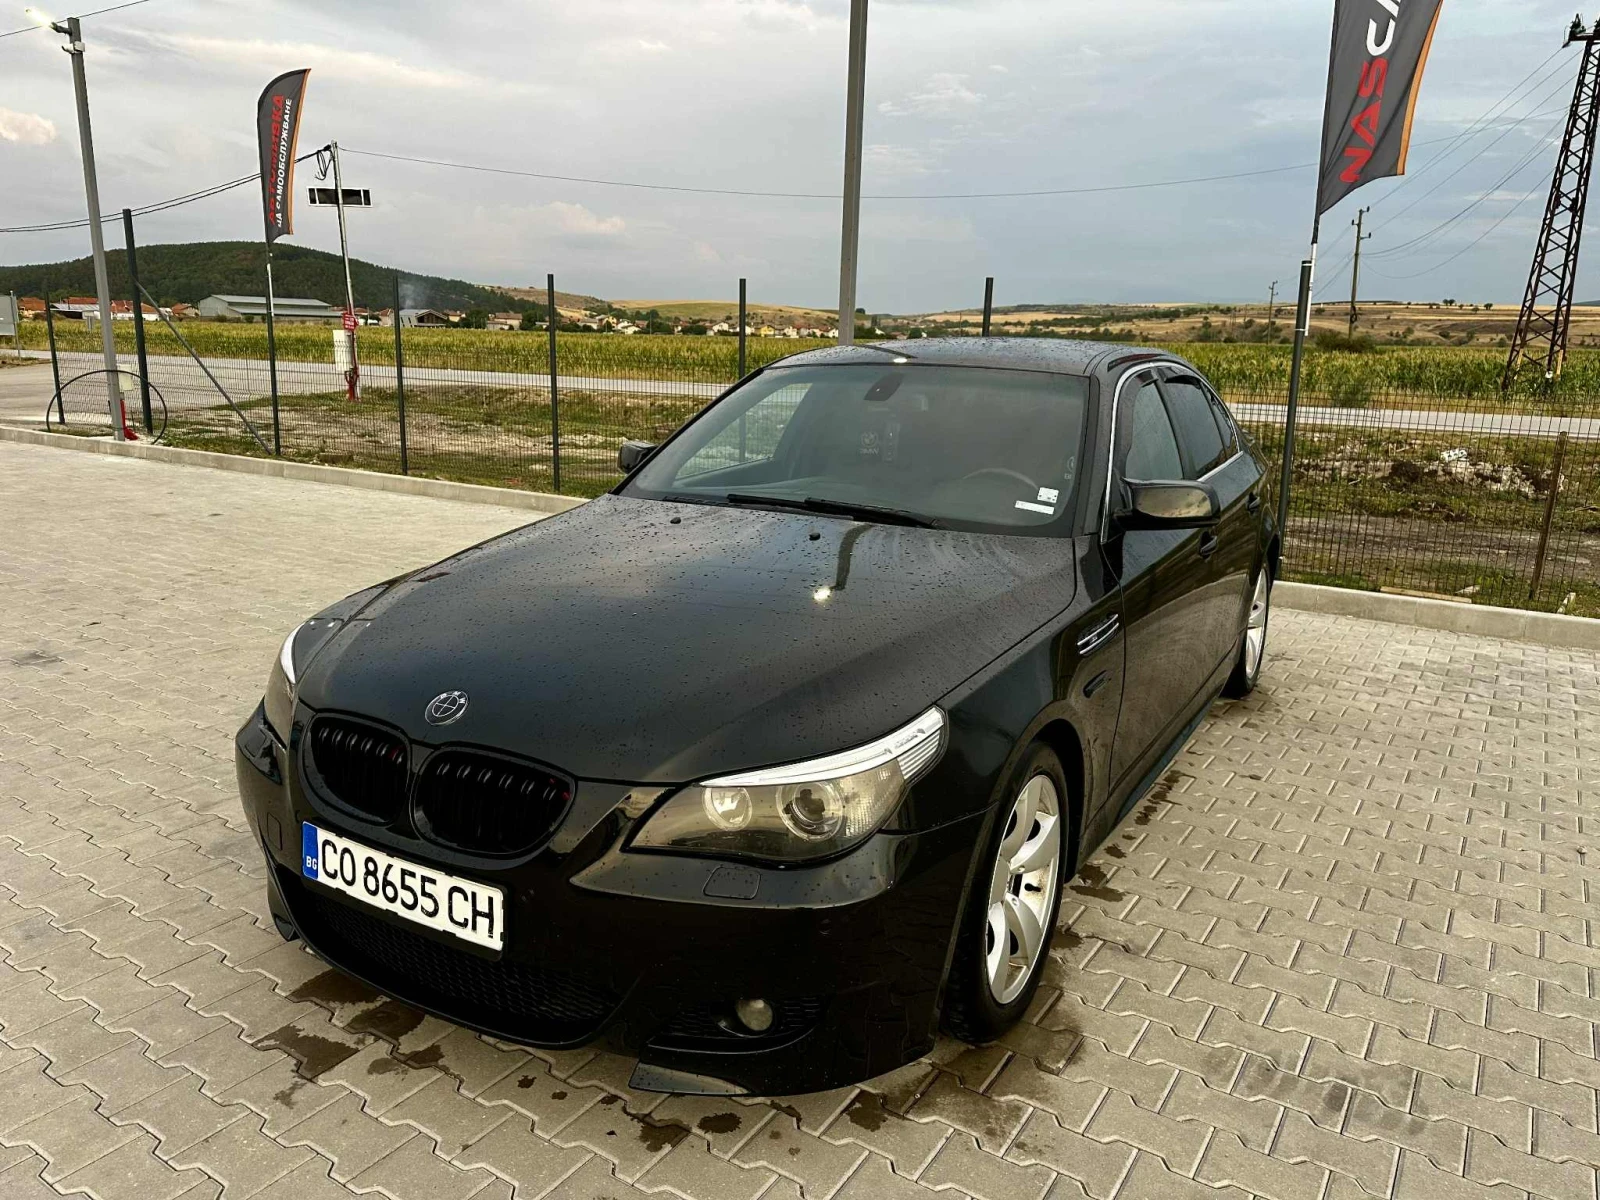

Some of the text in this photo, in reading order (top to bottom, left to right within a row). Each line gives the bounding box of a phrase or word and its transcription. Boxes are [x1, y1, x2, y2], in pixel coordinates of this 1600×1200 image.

[306, 855, 317, 870] BG
[363, 856, 440, 918] 8655
[448, 885, 494, 939] CH
